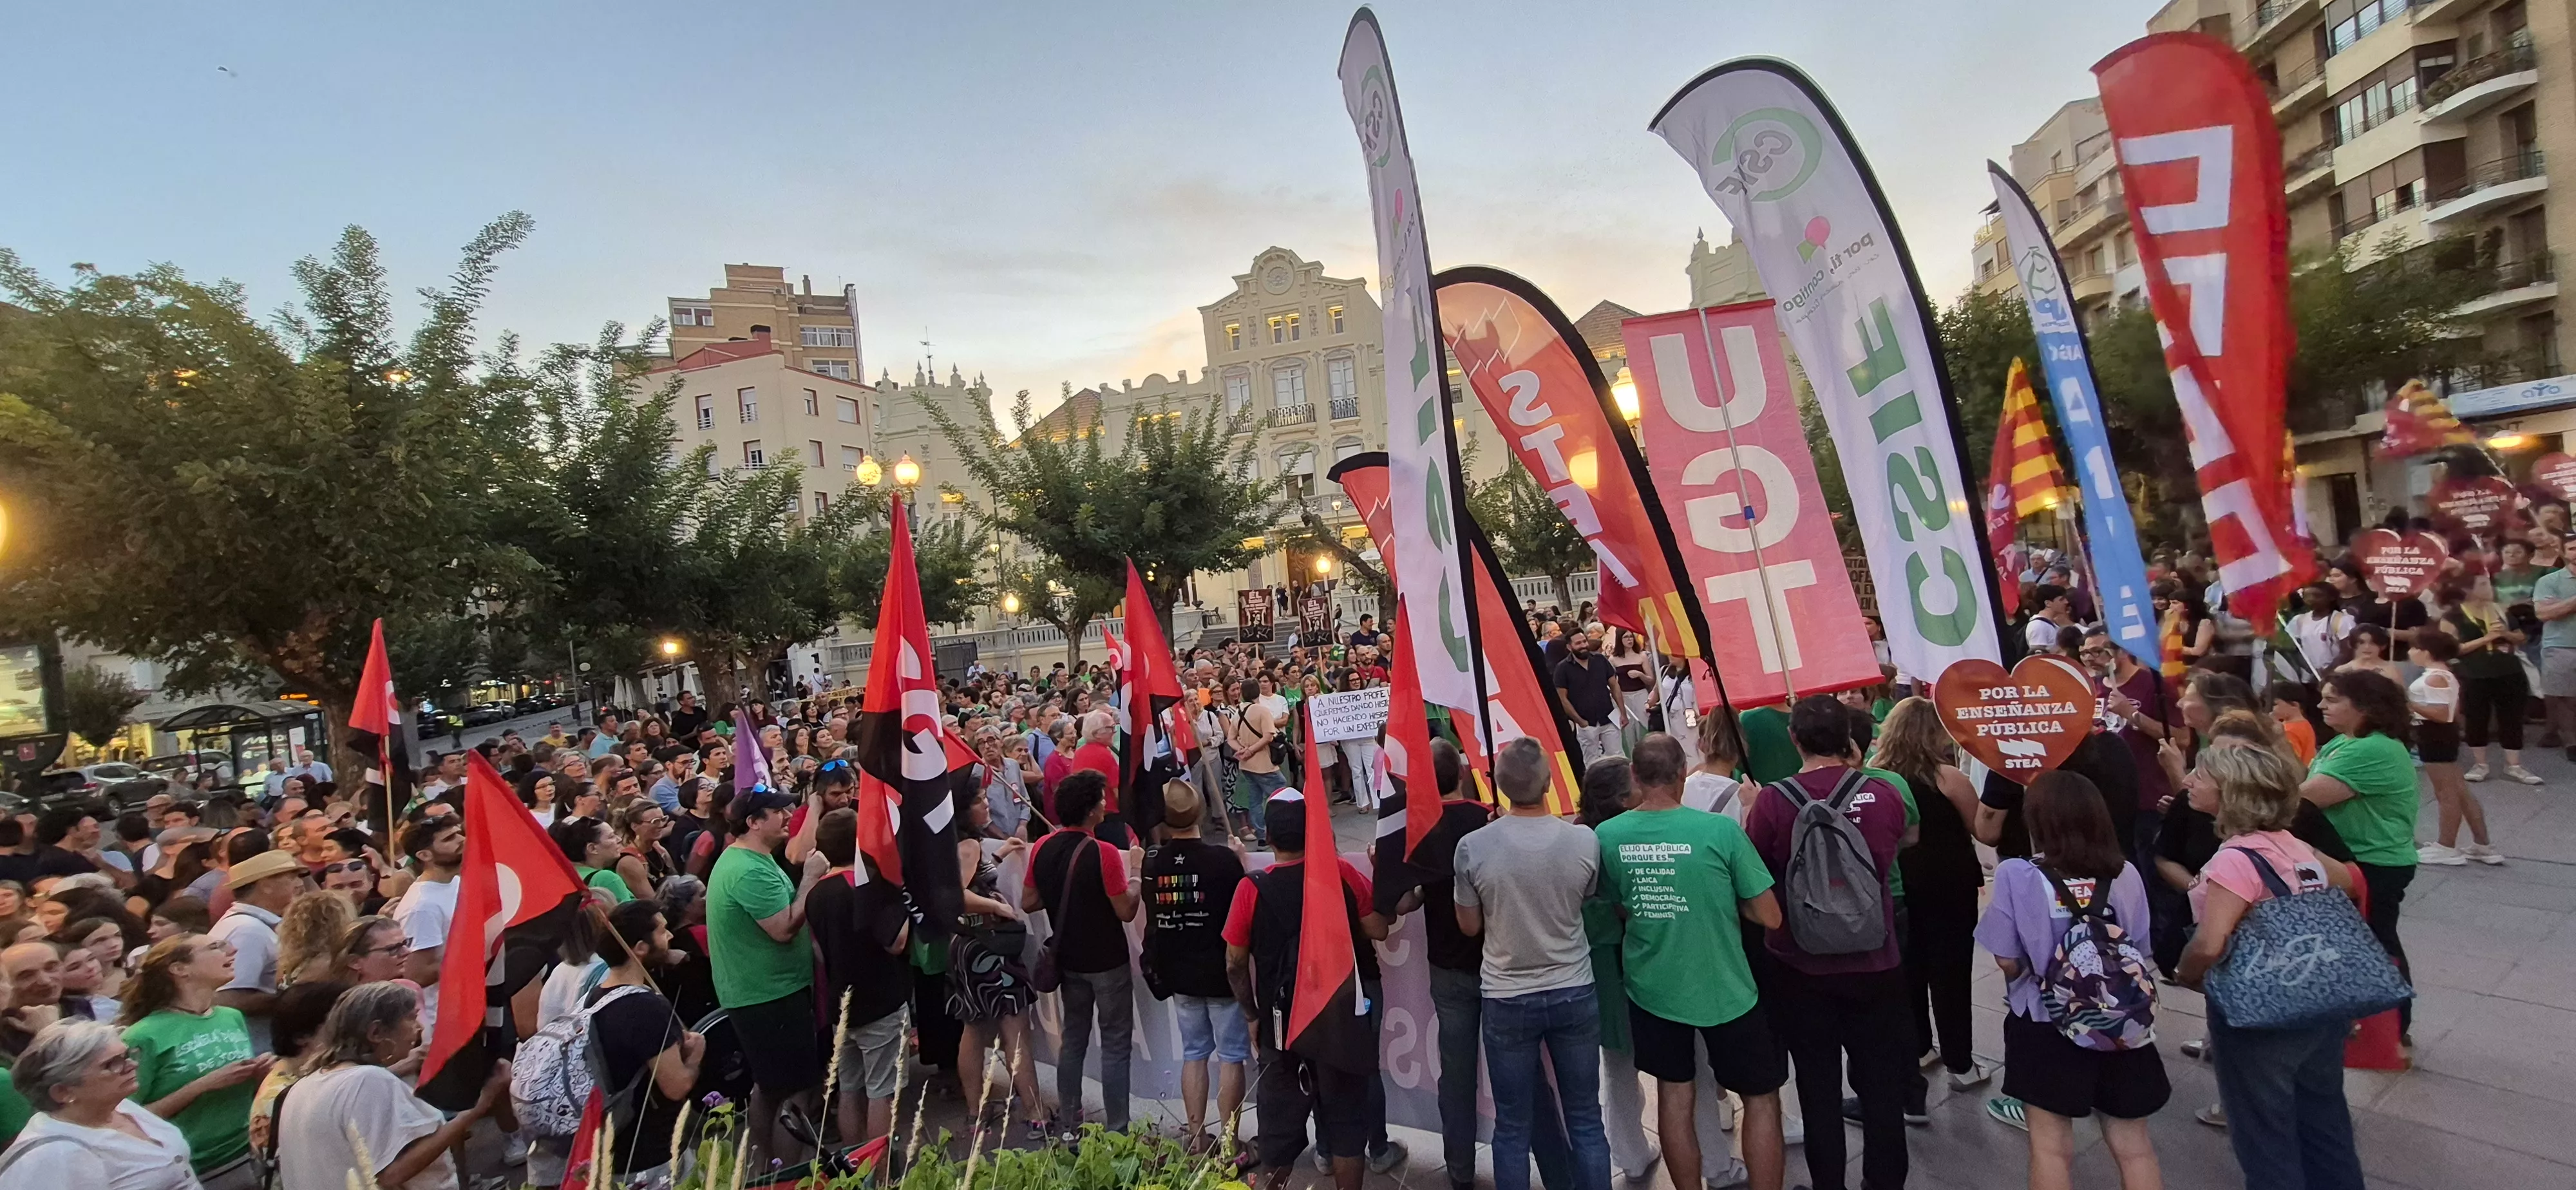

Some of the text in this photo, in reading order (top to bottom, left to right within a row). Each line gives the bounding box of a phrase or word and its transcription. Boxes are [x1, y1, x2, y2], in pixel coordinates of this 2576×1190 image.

[1318, 699, 1325, 708] A
[1328, 694, 1361, 706] NUESTRO
[1363, 690, 1386, 701] PROFE
[1979, 685, 2050, 700] POR LA
[1314, 705, 1350, 717] QUEREMOS
[1350, 701, 1374, 712] DANDO
[1955, 701, 2078, 720] ENSEÑANZA
[1316, 718, 1329, 727] NO
[1333, 713, 1367, 725] HACIENDO
[1323, 728, 1340, 737] POR
[1343, 723, 1354, 733] UN
[1976, 720, 2065, 737] PÚBLICA
[2005, 759, 2043, 769] STEA
[1655, 843, 1690, 852] PÚBLICA
